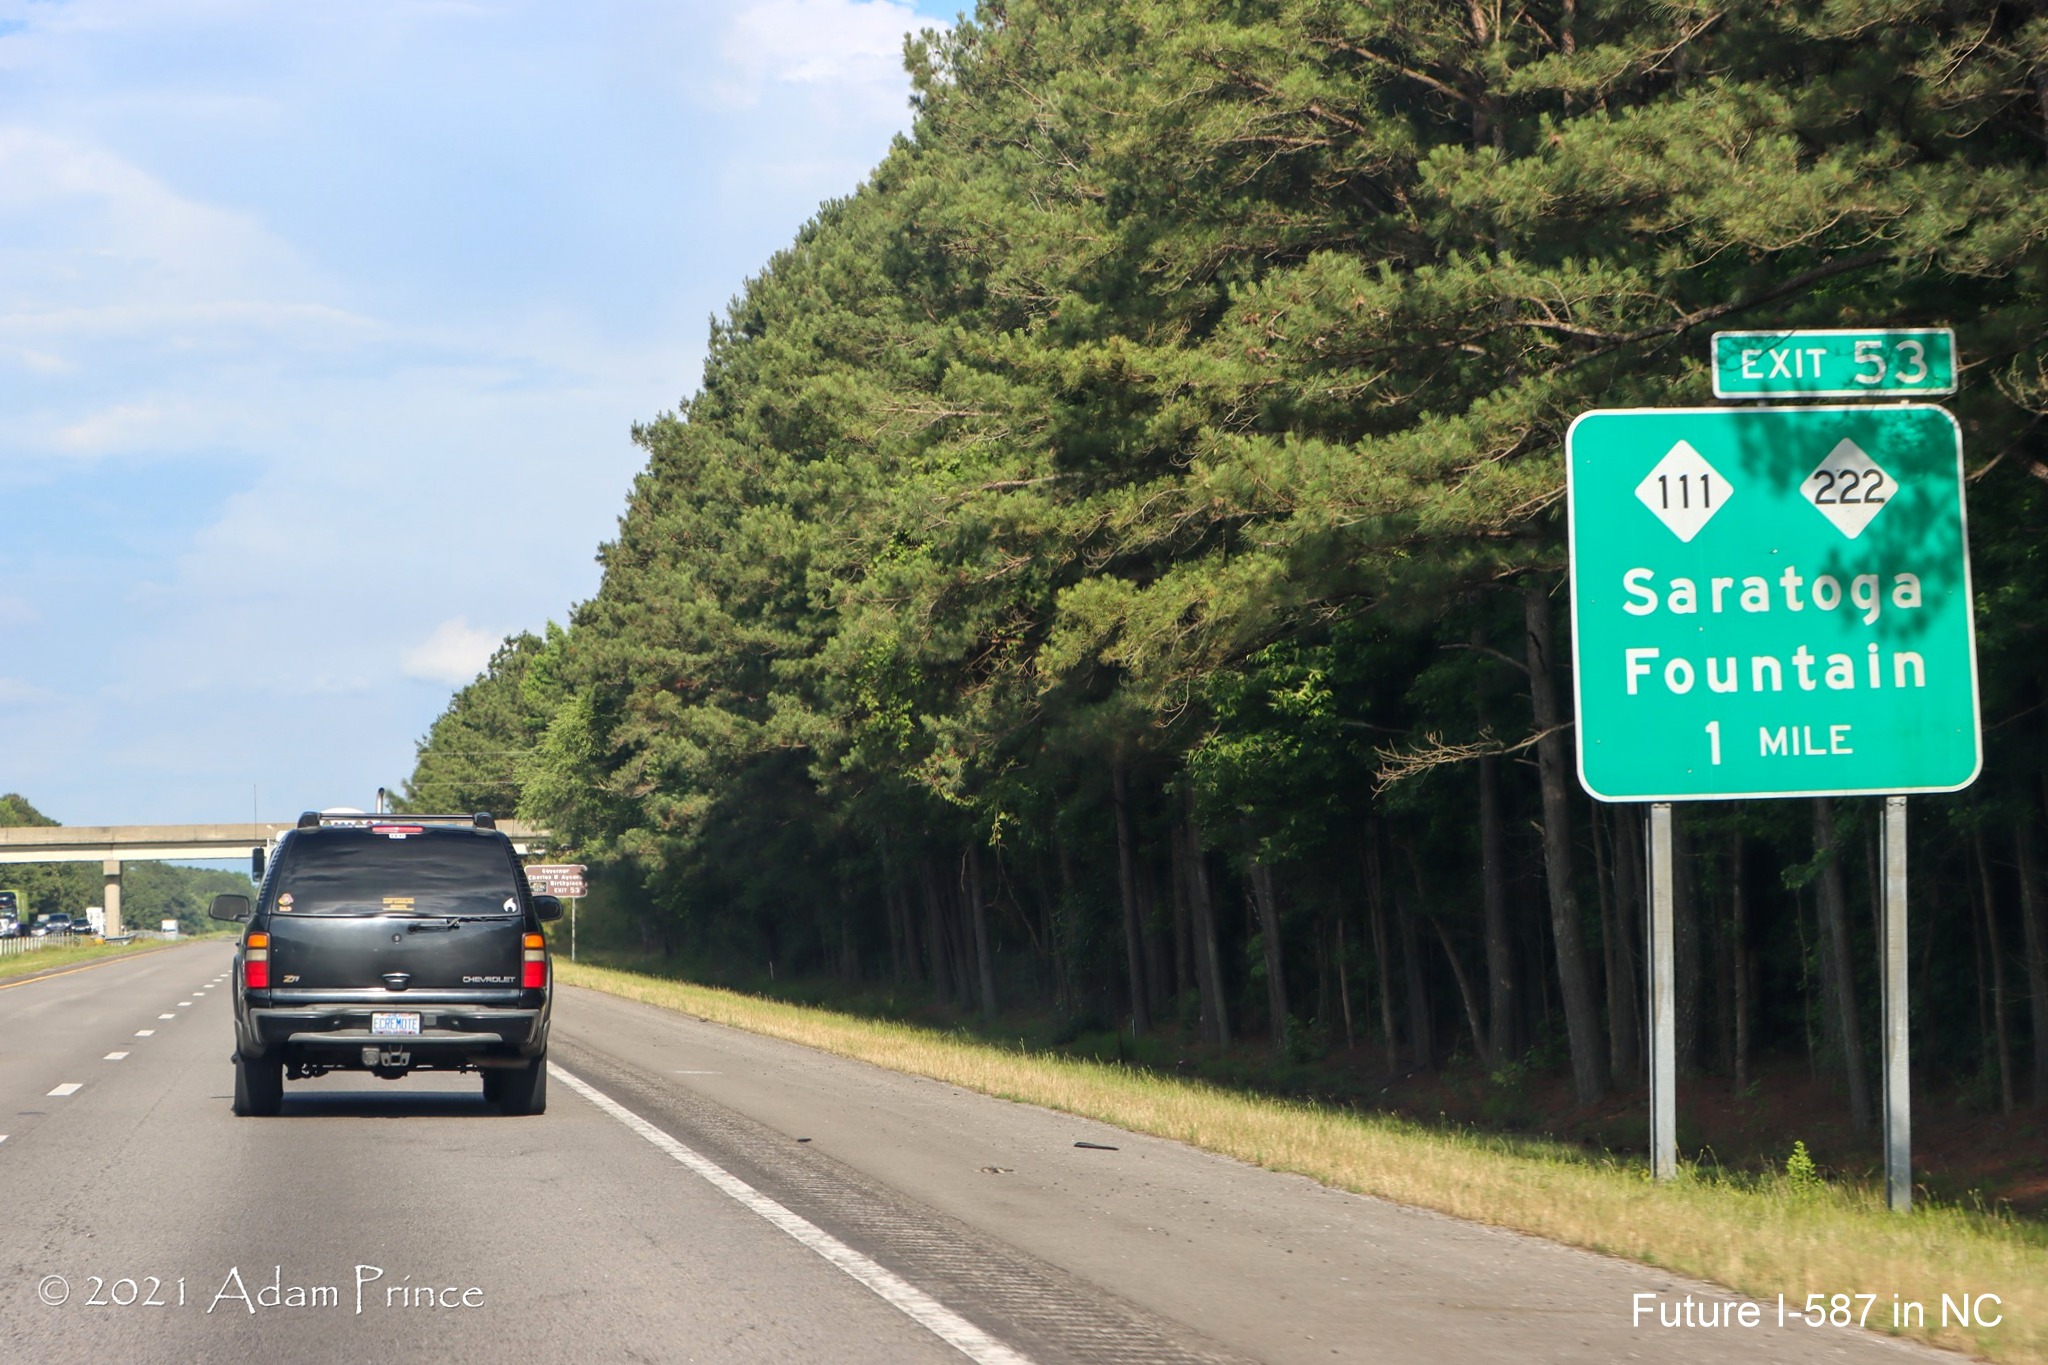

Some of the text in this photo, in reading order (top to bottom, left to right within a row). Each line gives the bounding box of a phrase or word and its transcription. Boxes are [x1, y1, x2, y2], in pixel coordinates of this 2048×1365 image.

[1742, 340, 1928, 385] EXIT 53
[1658, 474, 1711, 509] 111
[1813, 468, 1885, 505] 222
[1622, 566, 1922, 625] Saratoga
[1625, 643, 1926, 696] Fountain
[1705, 721, 1854, 765] 1 MILE
